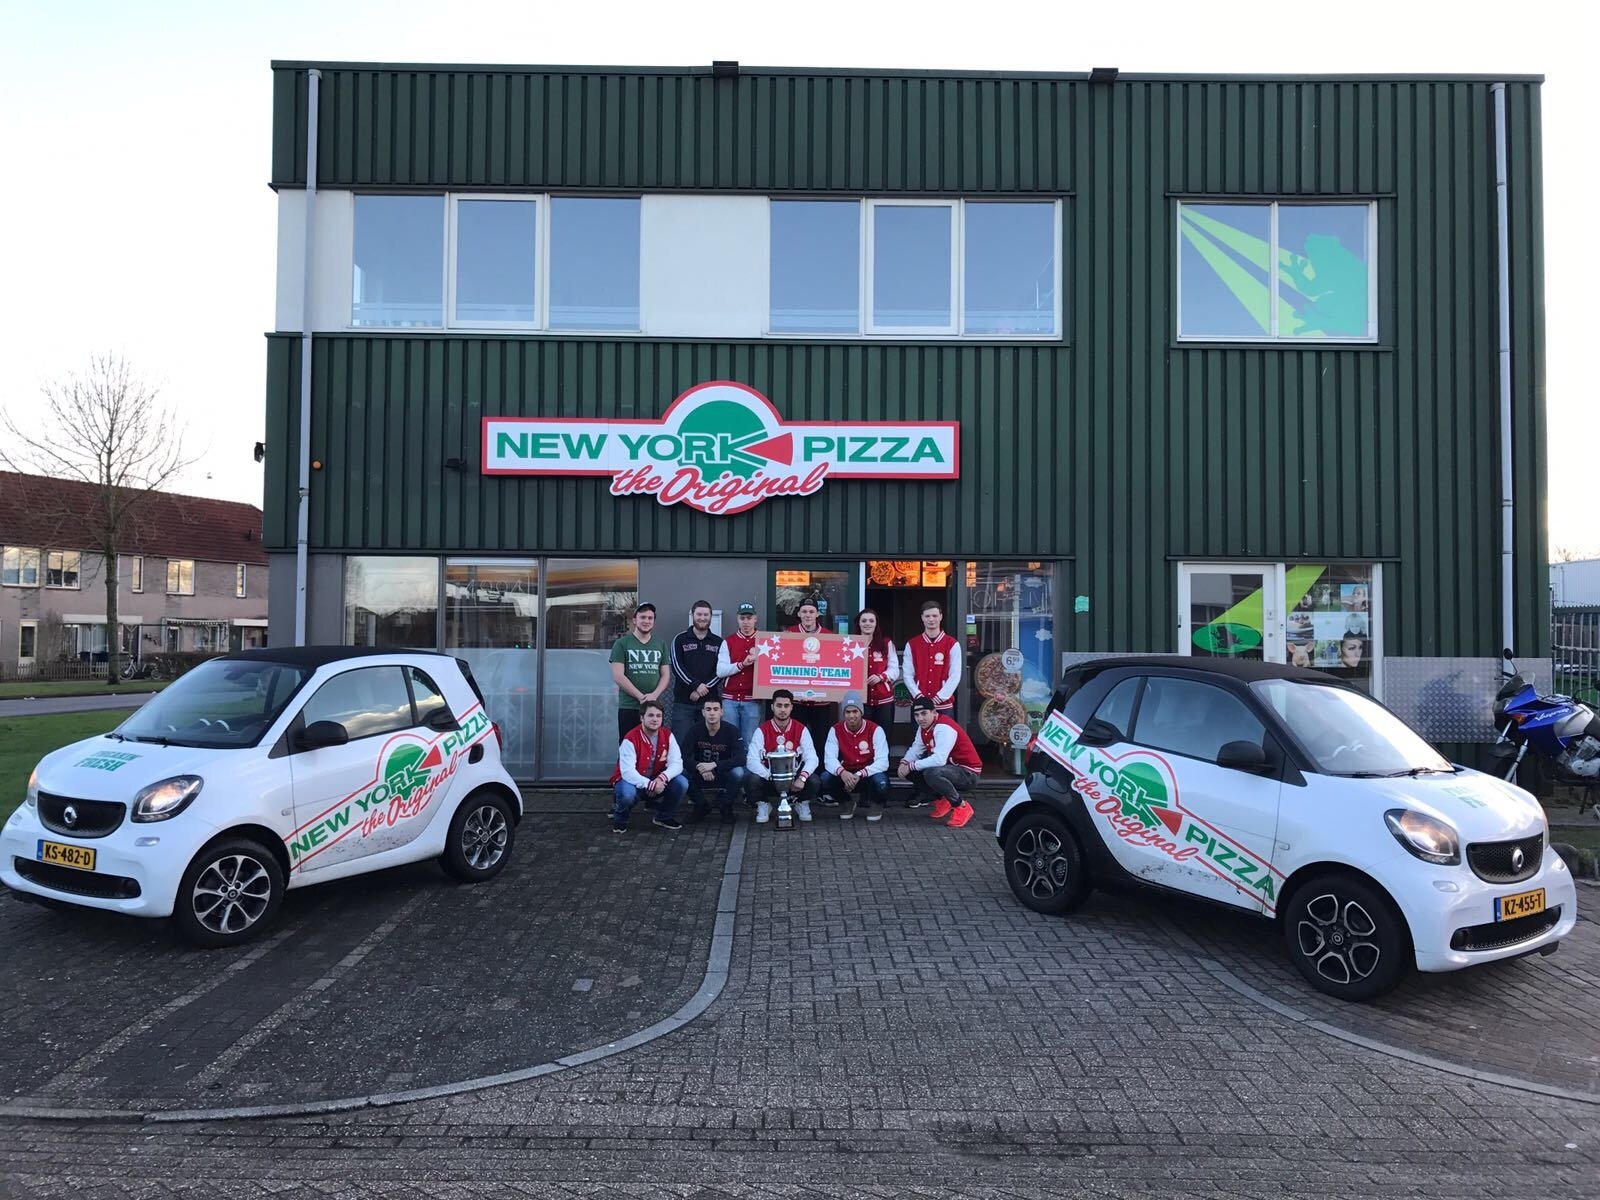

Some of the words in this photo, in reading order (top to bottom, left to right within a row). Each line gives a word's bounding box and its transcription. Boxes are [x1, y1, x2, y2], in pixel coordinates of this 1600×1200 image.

[497, 432, 608, 459] NEW
[618, 431, 768, 467] YORK
[803, 436, 945, 463] PIZZA
[613, 464, 664, 494] the
[659, 461, 829, 512] Original
[627, 649, 662, 663] NYP
[771, 666, 817, 677] WINNING
[820, 667, 850, 678] TEAM
[290, 806, 350, 860] NEW
[355, 752, 431, 813] YORK
[442, 711, 489, 756] PIZZA
[361, 808, 386, 838] the
[386, 750, 458, 827] Original
[1040, 720, 1086, 760] NEW
[1088, 752, 1168, 826] YORK
[1185, 823, 1275, 901] PIZZA
[1074, 775, 1100, 800] the
[1095, 795, 1200, 862] Original
[45, 844, 91, 866] KS-482-D
[1504, 893, 1542, 916] KZ-455-T
